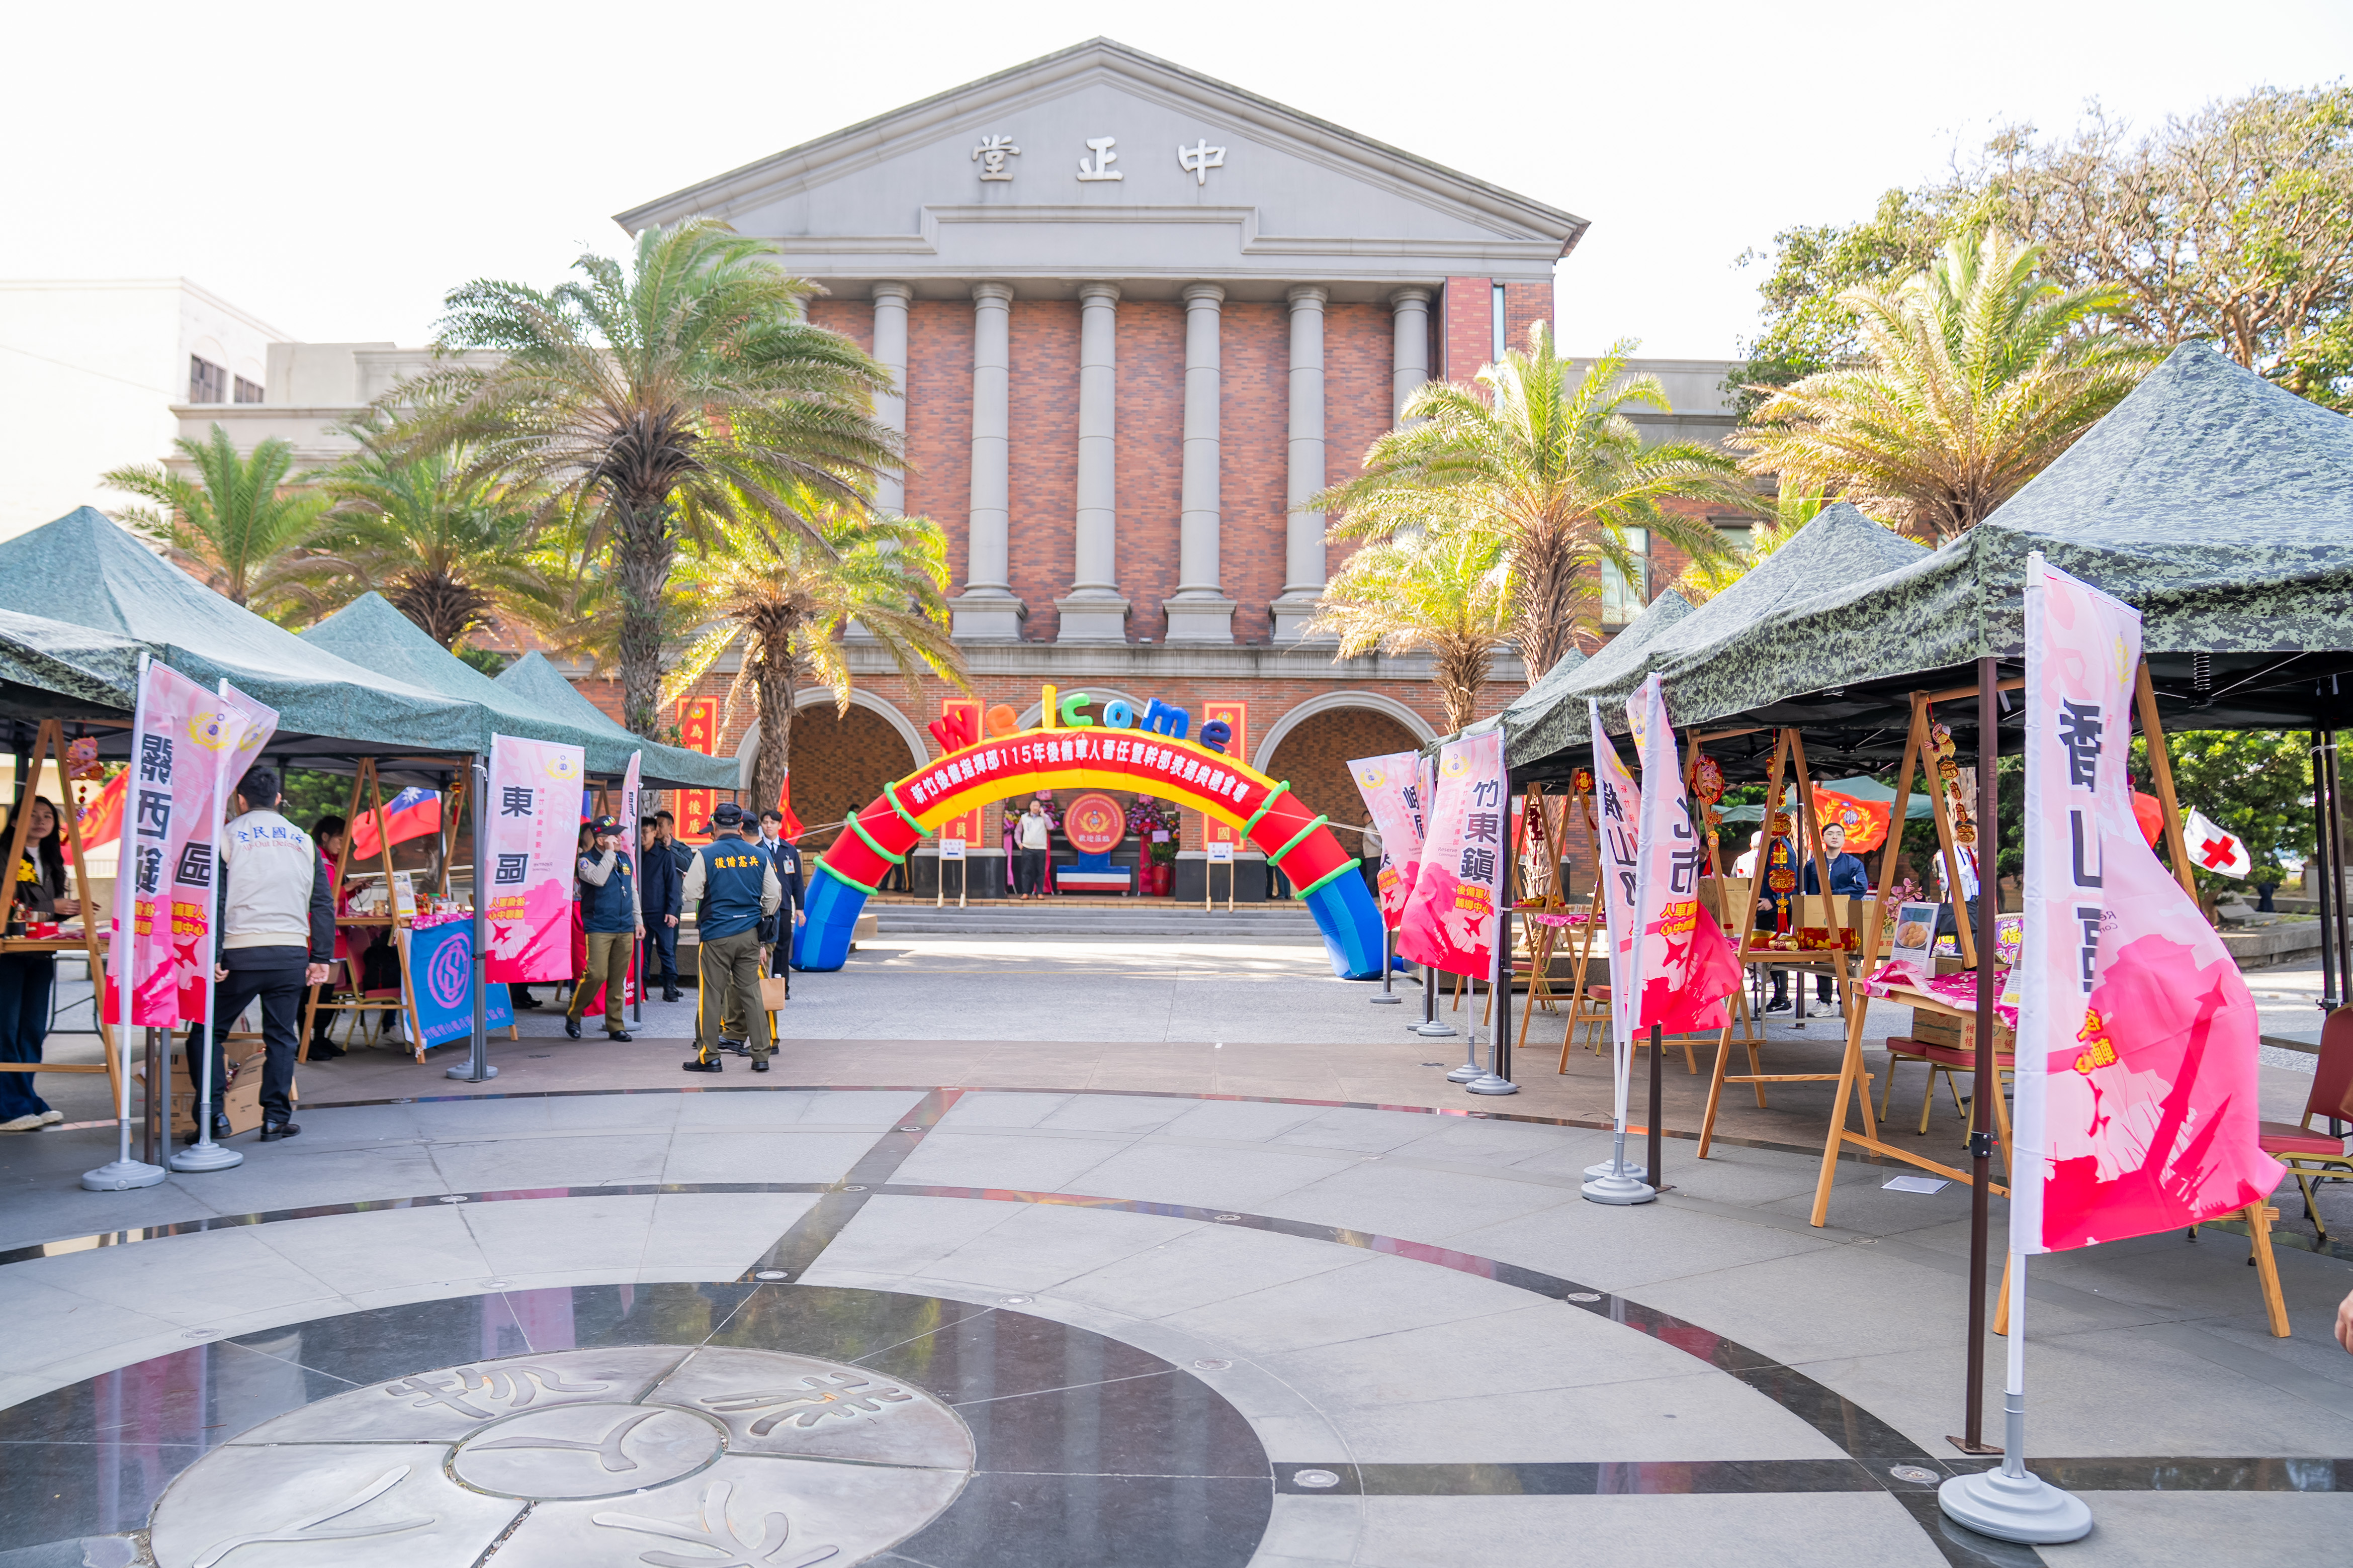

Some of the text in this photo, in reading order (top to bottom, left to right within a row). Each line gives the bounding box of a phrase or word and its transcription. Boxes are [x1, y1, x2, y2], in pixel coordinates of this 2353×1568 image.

[972, 134, 1227, 186] 中正堂
[928, 684, 1232, 753] Welcome
[910, 739, 1250, 804] 新竹後備指揮部115年後備軍人晉任暨幹部表揚典禮會場
[1460, 780, 1499, 885] 竹東鎮
[715, 855, 759, 869] 後備憲兵
[1455, 897, 1489, 915] 輔導中心
[1456, 884, 1491, 902] 後備軍人
[1965, 1024, 1975, 1047] 柑桔
